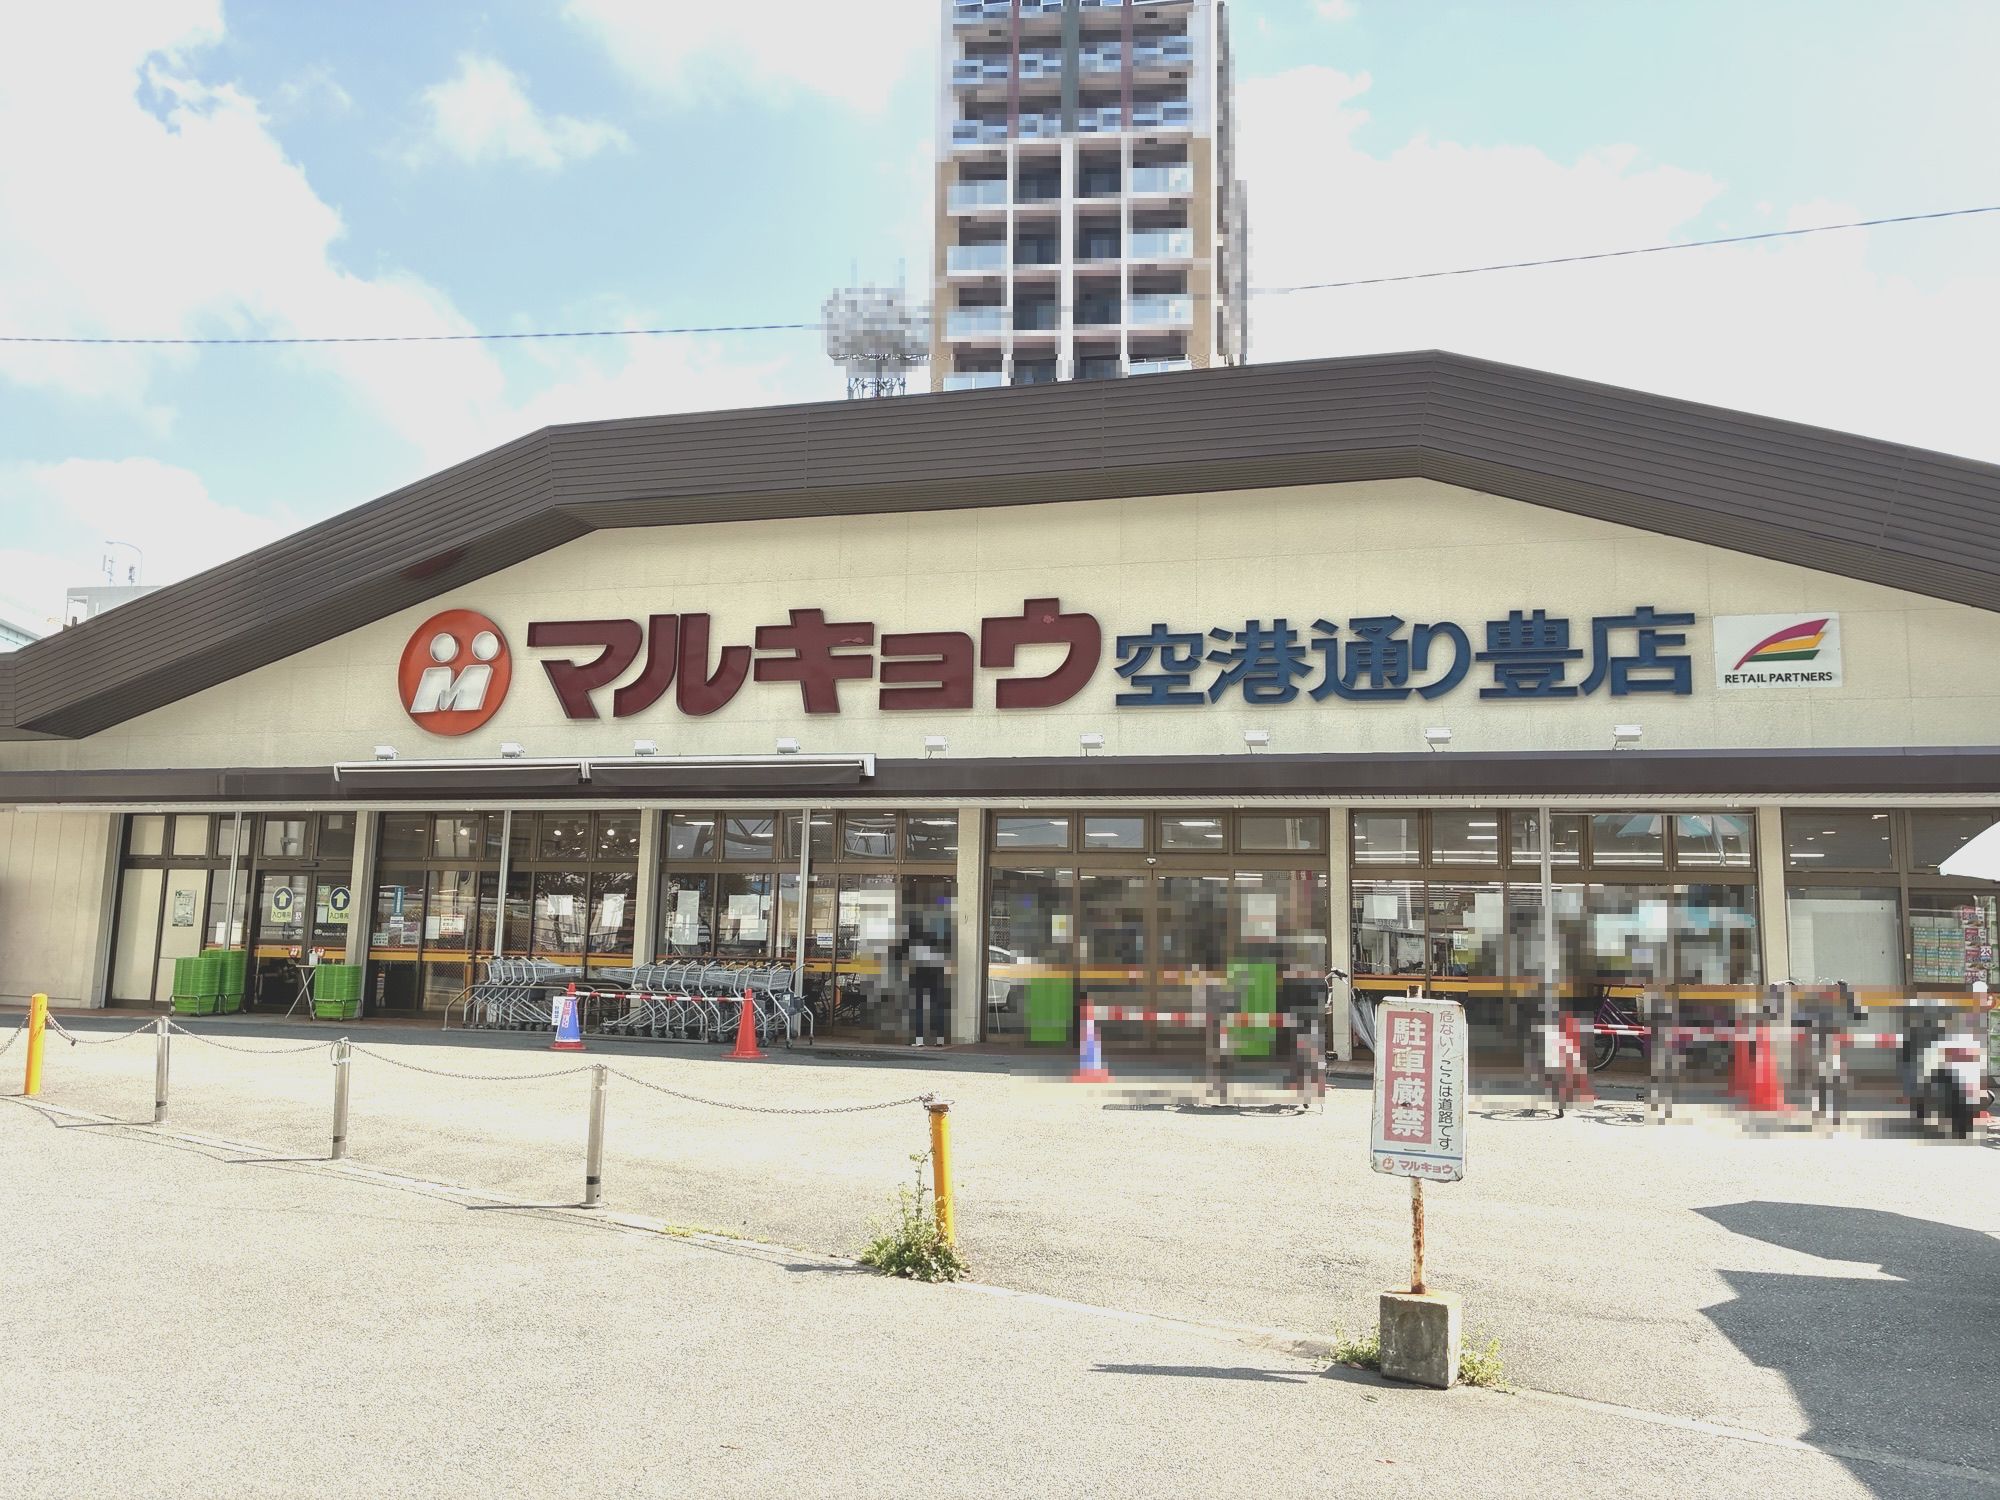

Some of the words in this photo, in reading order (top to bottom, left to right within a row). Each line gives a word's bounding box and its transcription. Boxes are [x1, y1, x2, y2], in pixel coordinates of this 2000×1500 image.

[526, 597, 1101, 720] マルキョウ
[1114, 604, 1696, 707] 空港通り豊店
[1724, 674, 1767, 684] RETAIL
[1769, 671, 1833, 683] PARTNERS
[1391, 1016, 1426, 1138] 駐車厳禁
[1398, 1159, 1453, 1174] マルキョウ
